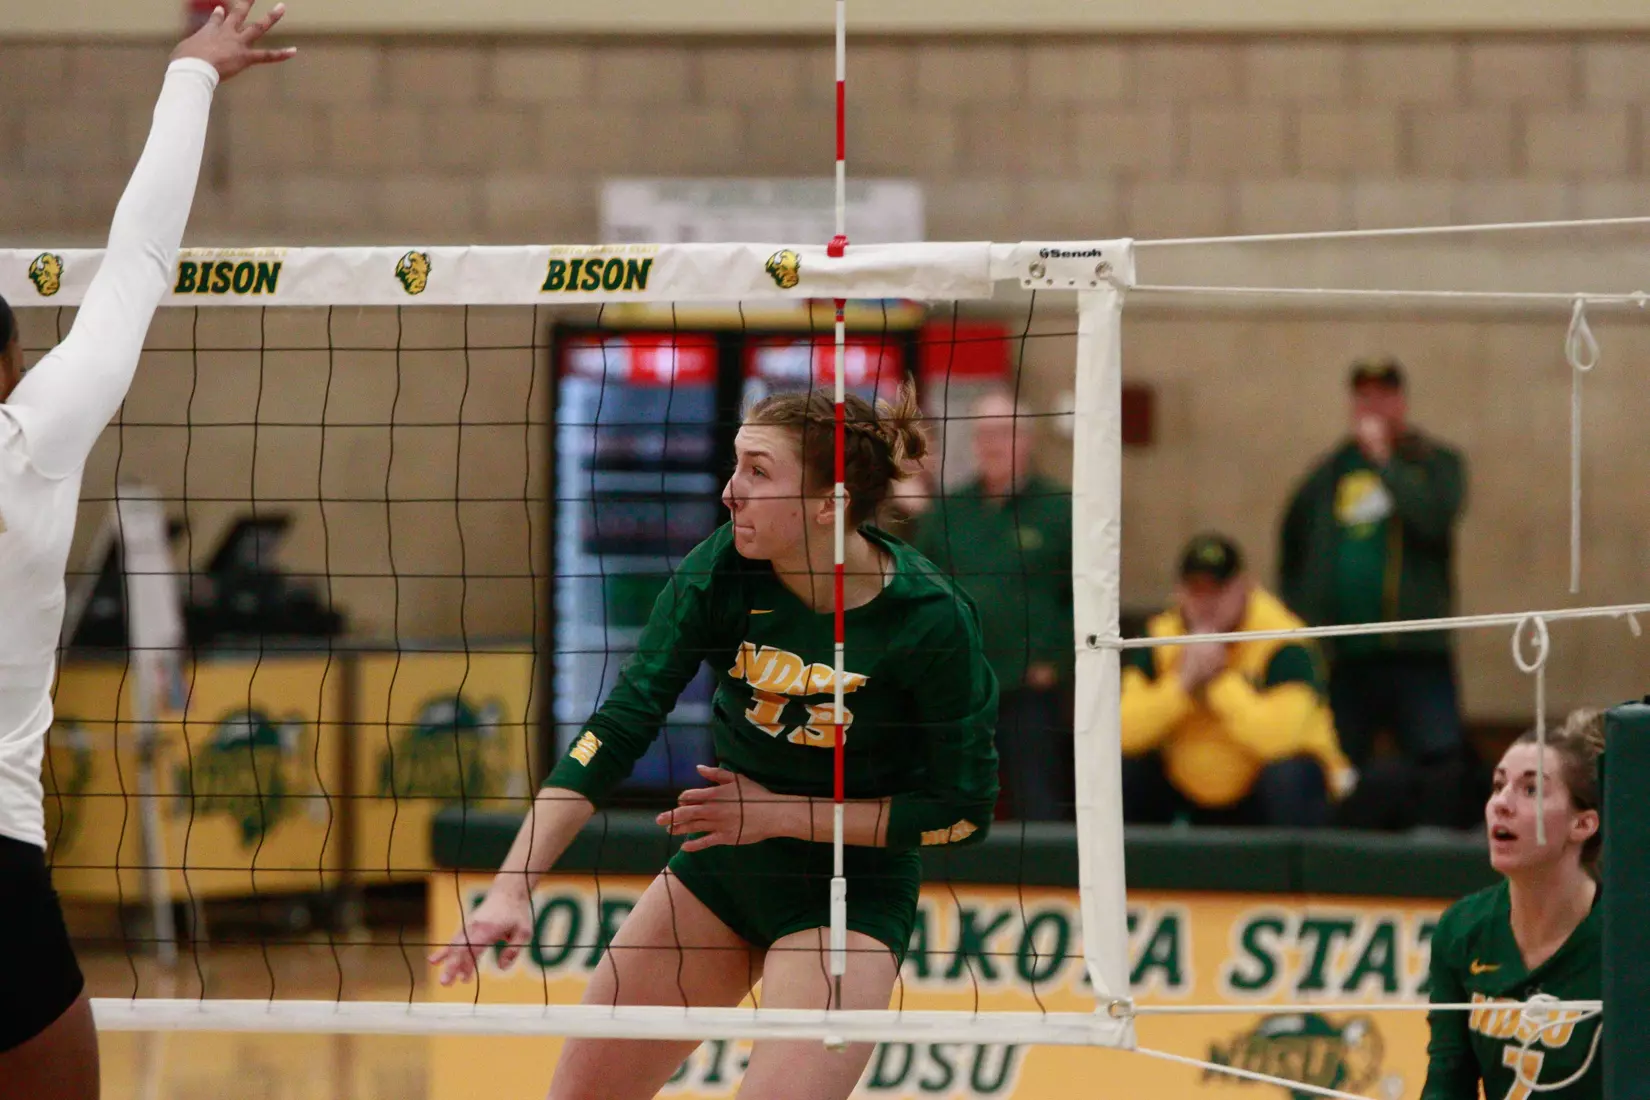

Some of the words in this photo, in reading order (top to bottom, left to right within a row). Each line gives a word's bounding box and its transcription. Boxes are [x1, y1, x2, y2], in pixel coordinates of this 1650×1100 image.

[173, 259, 283, 295] BISON
[541, 257, 654, 293] BISON
[896, 908, 1182, 987] AKOA
[1229, 918, 1438, 994] STA
[1502, 1045, 1546, 1100] 7
